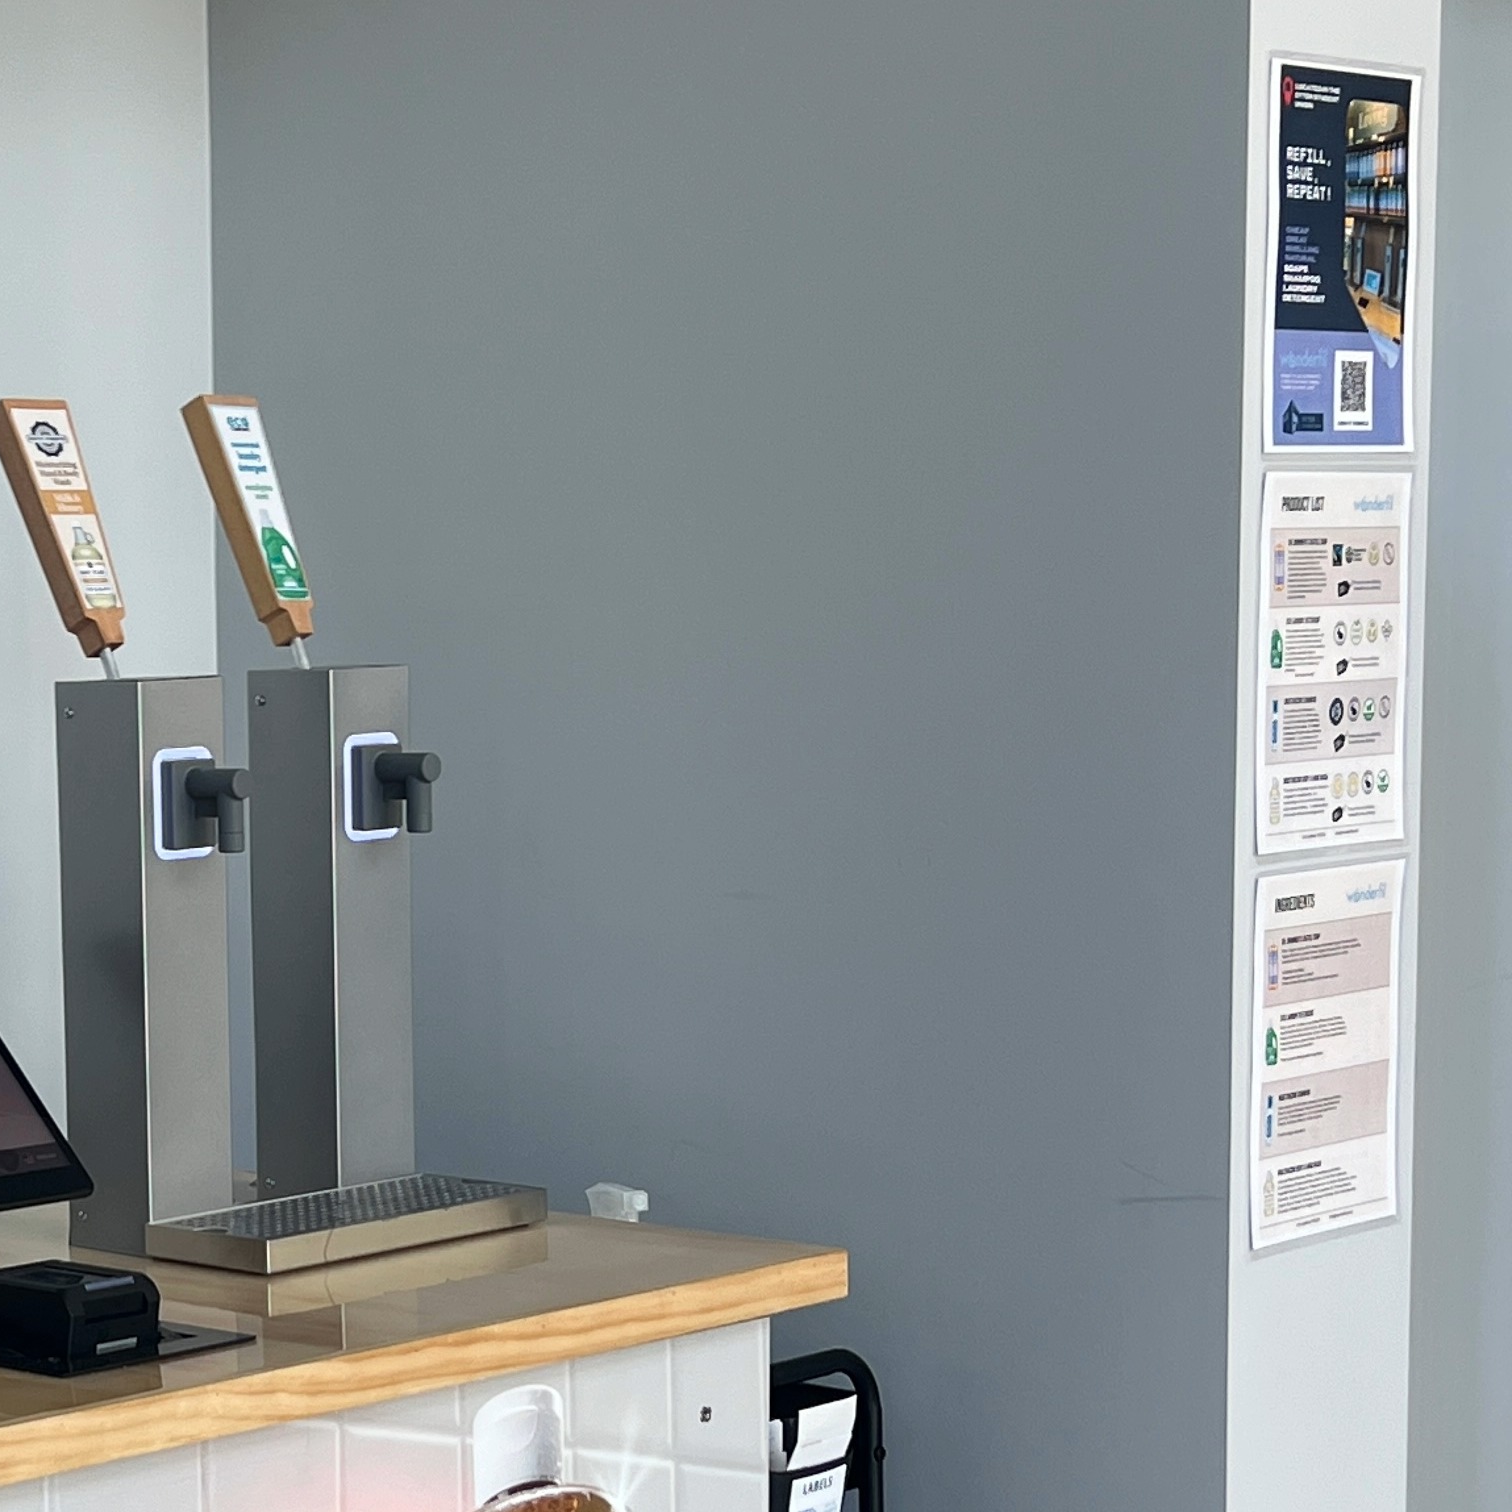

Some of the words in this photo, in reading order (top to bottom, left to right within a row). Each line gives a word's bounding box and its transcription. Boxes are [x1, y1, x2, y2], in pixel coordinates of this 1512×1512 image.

[1286, 146, 1331, 166] REFILL,
[1286, 166, 1319, 184] SAVE,
[1286, 184, 1331, 201] REPEAT!
[803, 1476, 833, 1495] LABELS
